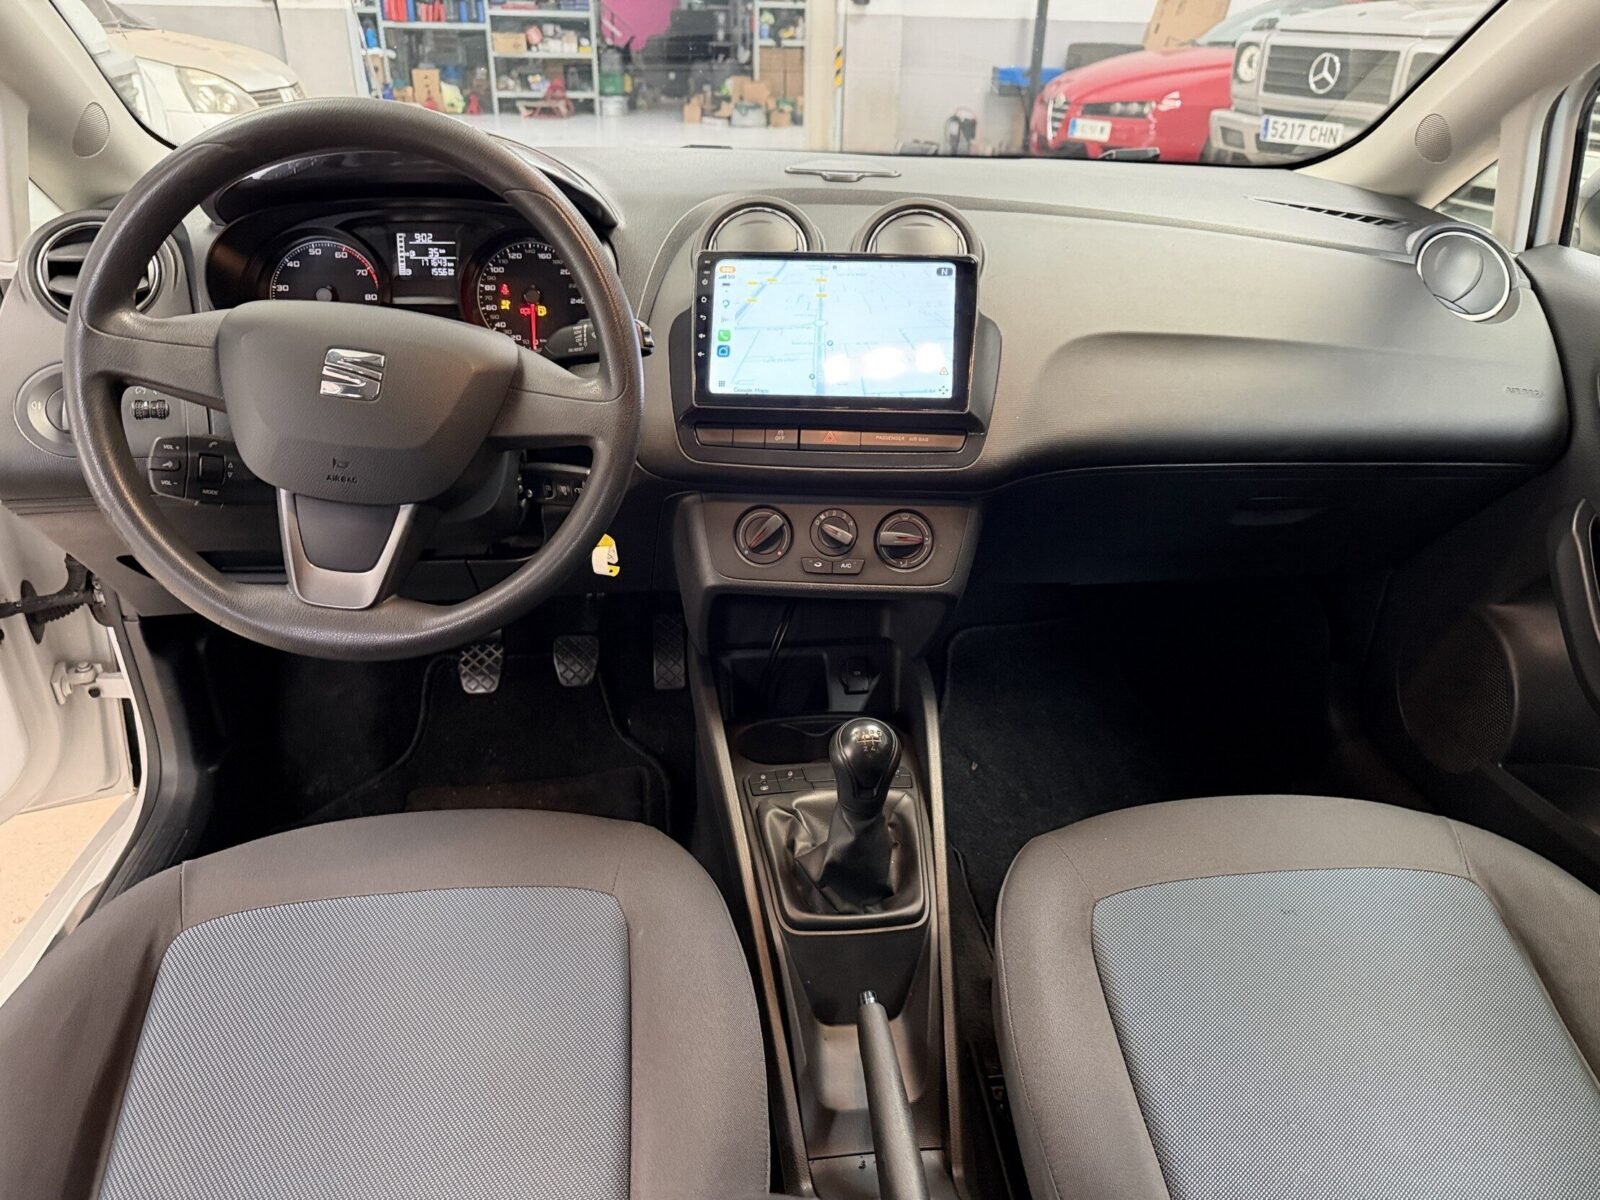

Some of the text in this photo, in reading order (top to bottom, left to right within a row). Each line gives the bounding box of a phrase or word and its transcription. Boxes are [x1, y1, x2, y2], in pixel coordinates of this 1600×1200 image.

[1271, 120, 1339, 145] 5217 CHN
[308, 248, 322, 256] 50
[334, 251, 348, 259] 60
[428, 247, 439, 257] 35
[508, 252, 522, 260] 120
[538, 252, 552, 260] 160
[287, 260, 300, 268] 40
[356, 269, 368, 277] 70
[276, 284, 289, 292] 30
[364, 293, 378, 301] 80
[485, 304, 498, 312] 60
[494, 321, 507, 329] 40
[202, 488, 219, 496] MODE
